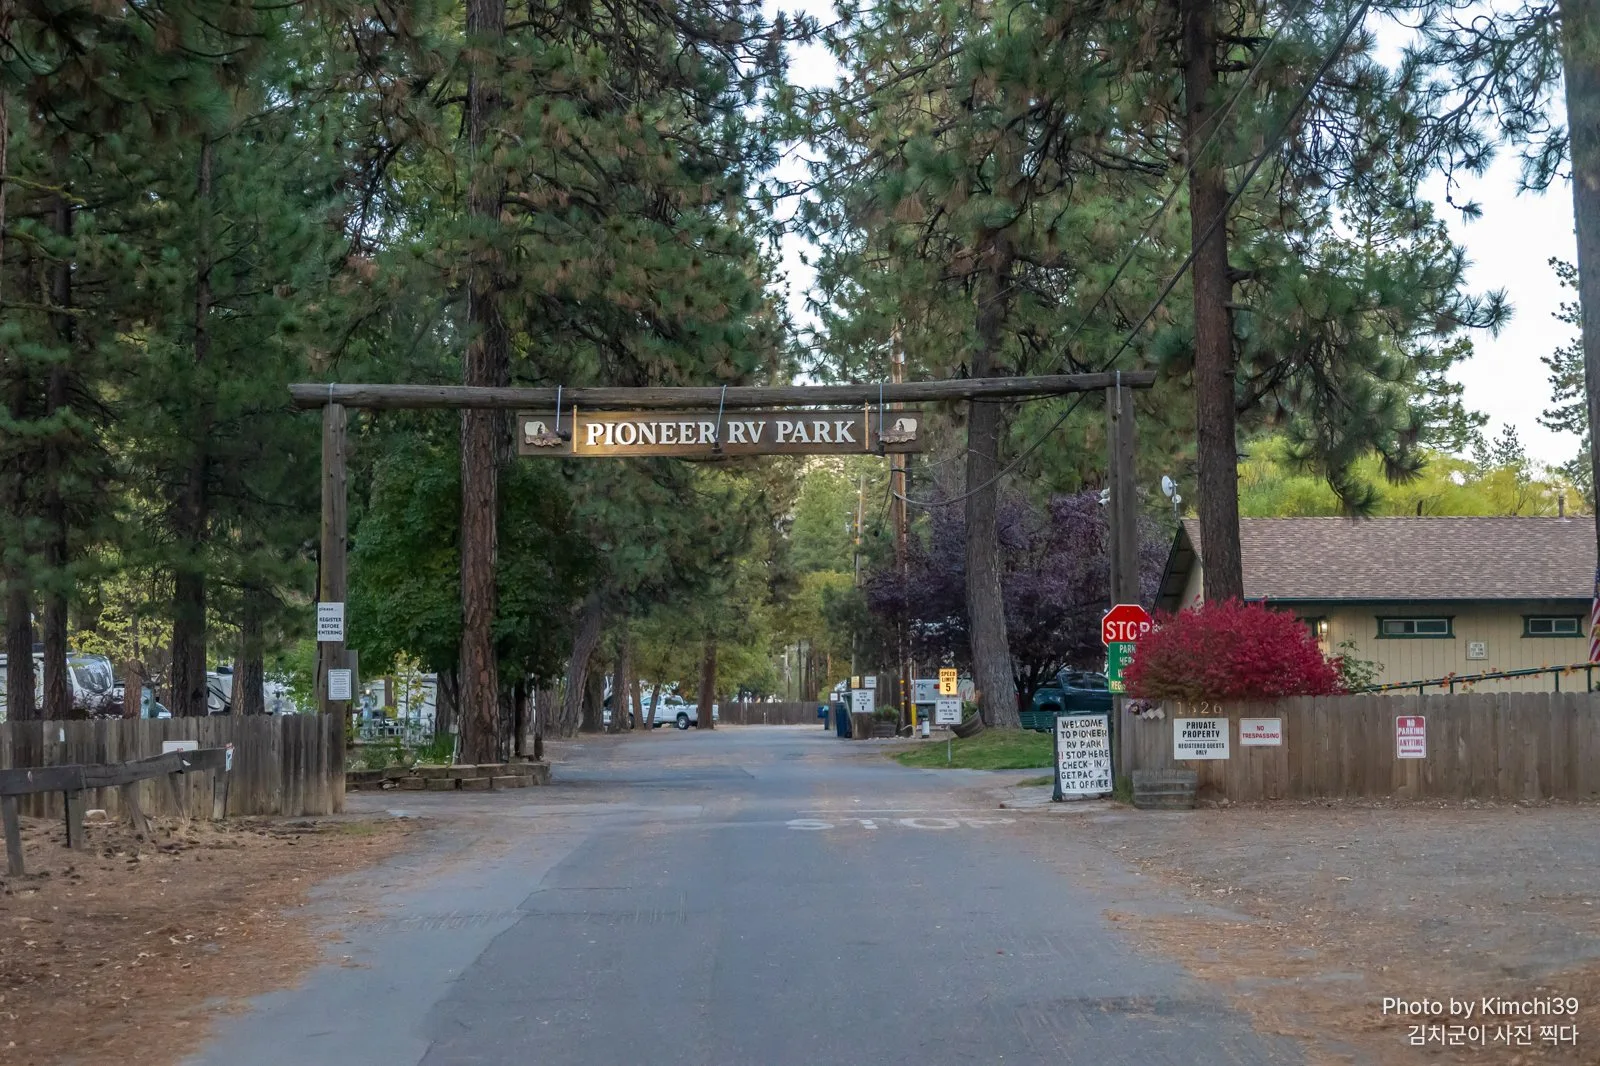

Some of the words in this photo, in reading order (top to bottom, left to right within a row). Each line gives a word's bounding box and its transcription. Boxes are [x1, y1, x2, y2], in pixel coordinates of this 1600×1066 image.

[586, 422, 716, 446] PIONEER
[727, 421, 766, 444] RV
[775, 420, 856, 444] PARK
[946, 683, 950, 692] 5
[1062, 719, 1104, 728] WELCOME
[1186, 722, 1216, 730] PRIVATE
[1407, 719, 1415, 727] NO
[1061, 731, 1070, 739] TO
[1072, 729, 1108, 738] PIONEER
[1066, 751, 1086, 760] STOP
[1088, 750, 1108, 758] HERE
[1061, 771, 1076, 780] GET
